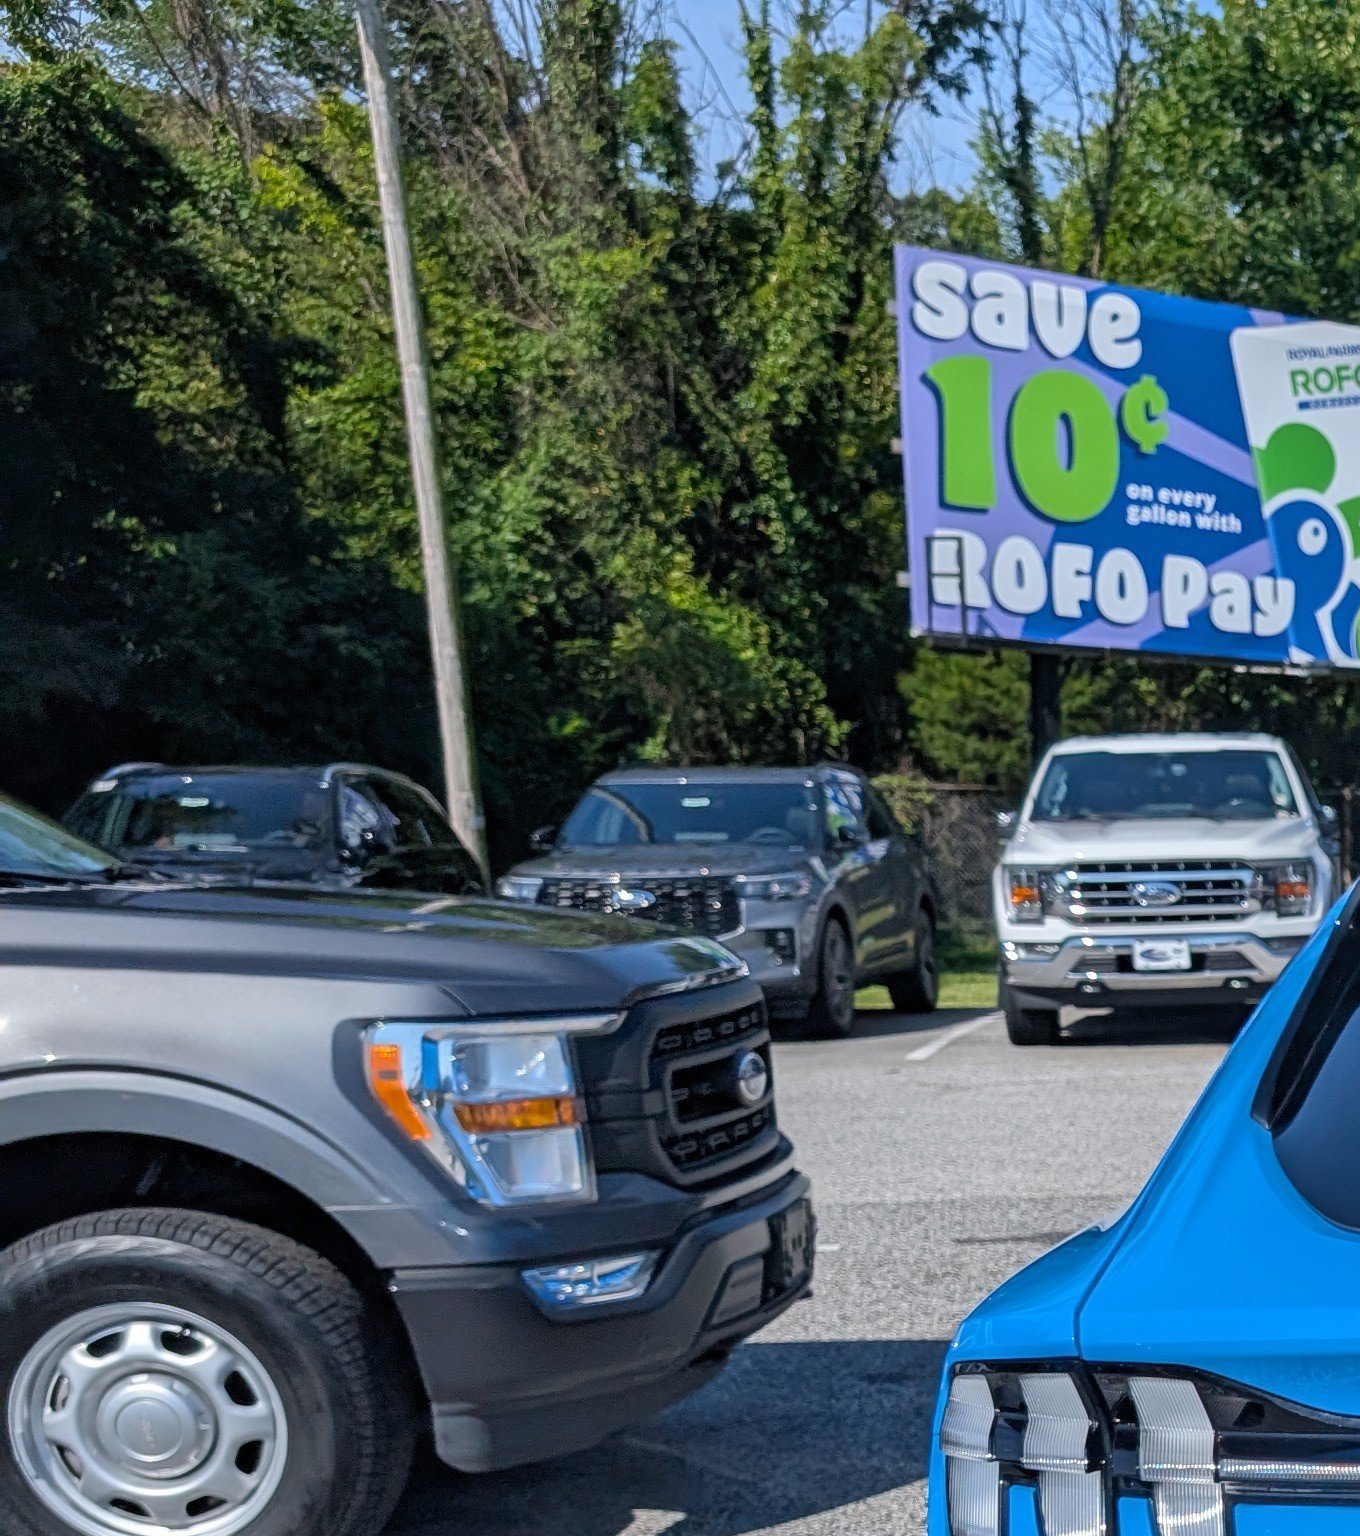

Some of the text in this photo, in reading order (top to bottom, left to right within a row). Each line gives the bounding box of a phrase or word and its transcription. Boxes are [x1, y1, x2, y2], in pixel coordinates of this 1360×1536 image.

[1126, 483, 1216, 514] on every
[1126, 503, 1242, 534] gallon with
[931, 528, 1148, 625] ROFO
